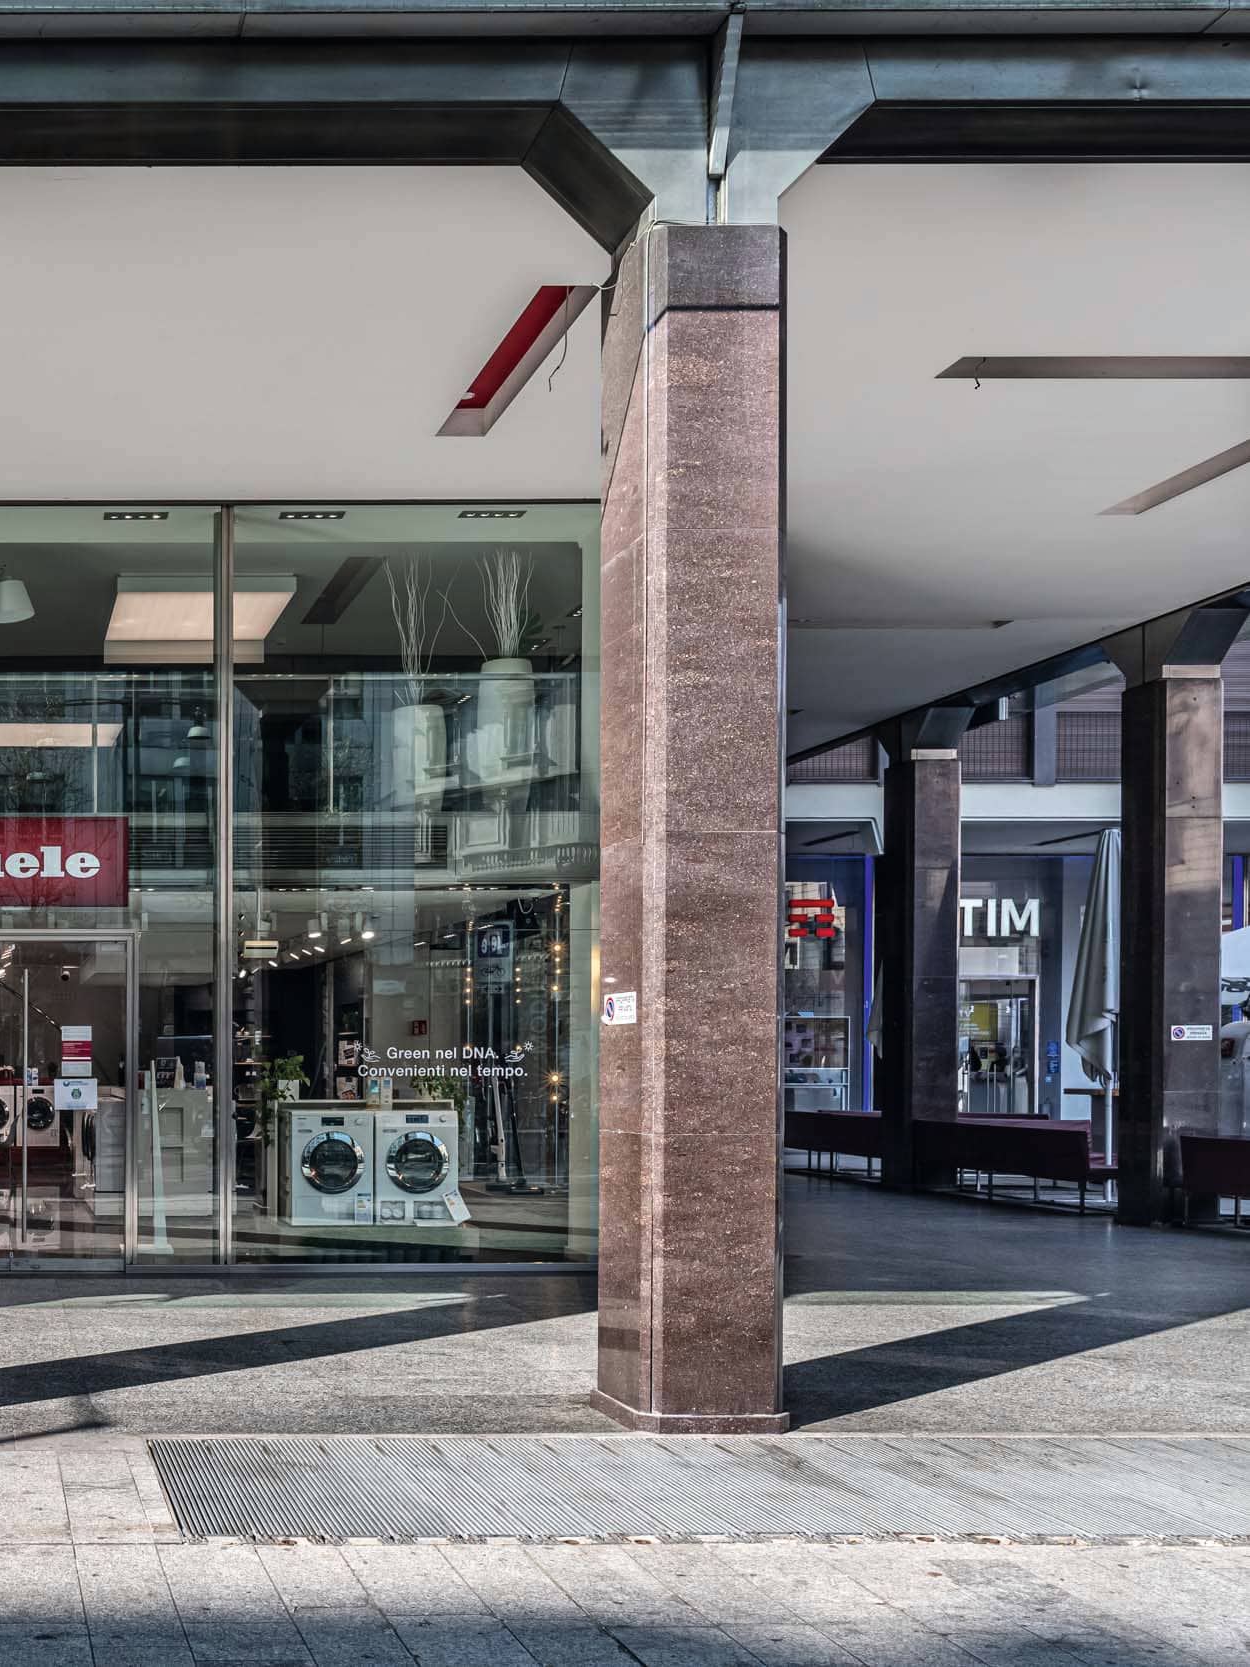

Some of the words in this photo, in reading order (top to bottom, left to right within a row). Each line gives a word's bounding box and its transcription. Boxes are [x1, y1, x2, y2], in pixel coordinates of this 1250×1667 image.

[959, 899, 1040, 936] TIM
[386, 1047, 430, 1060] Green
[435, 1047, 457, 1060] nel
[462, 1047, 499, 1060] DNA.
[357, 1064, 445, 1077] Convenienti
[450, 1064, 472, 1077] nel
[476, 1065, 528, 1080] tempo.
